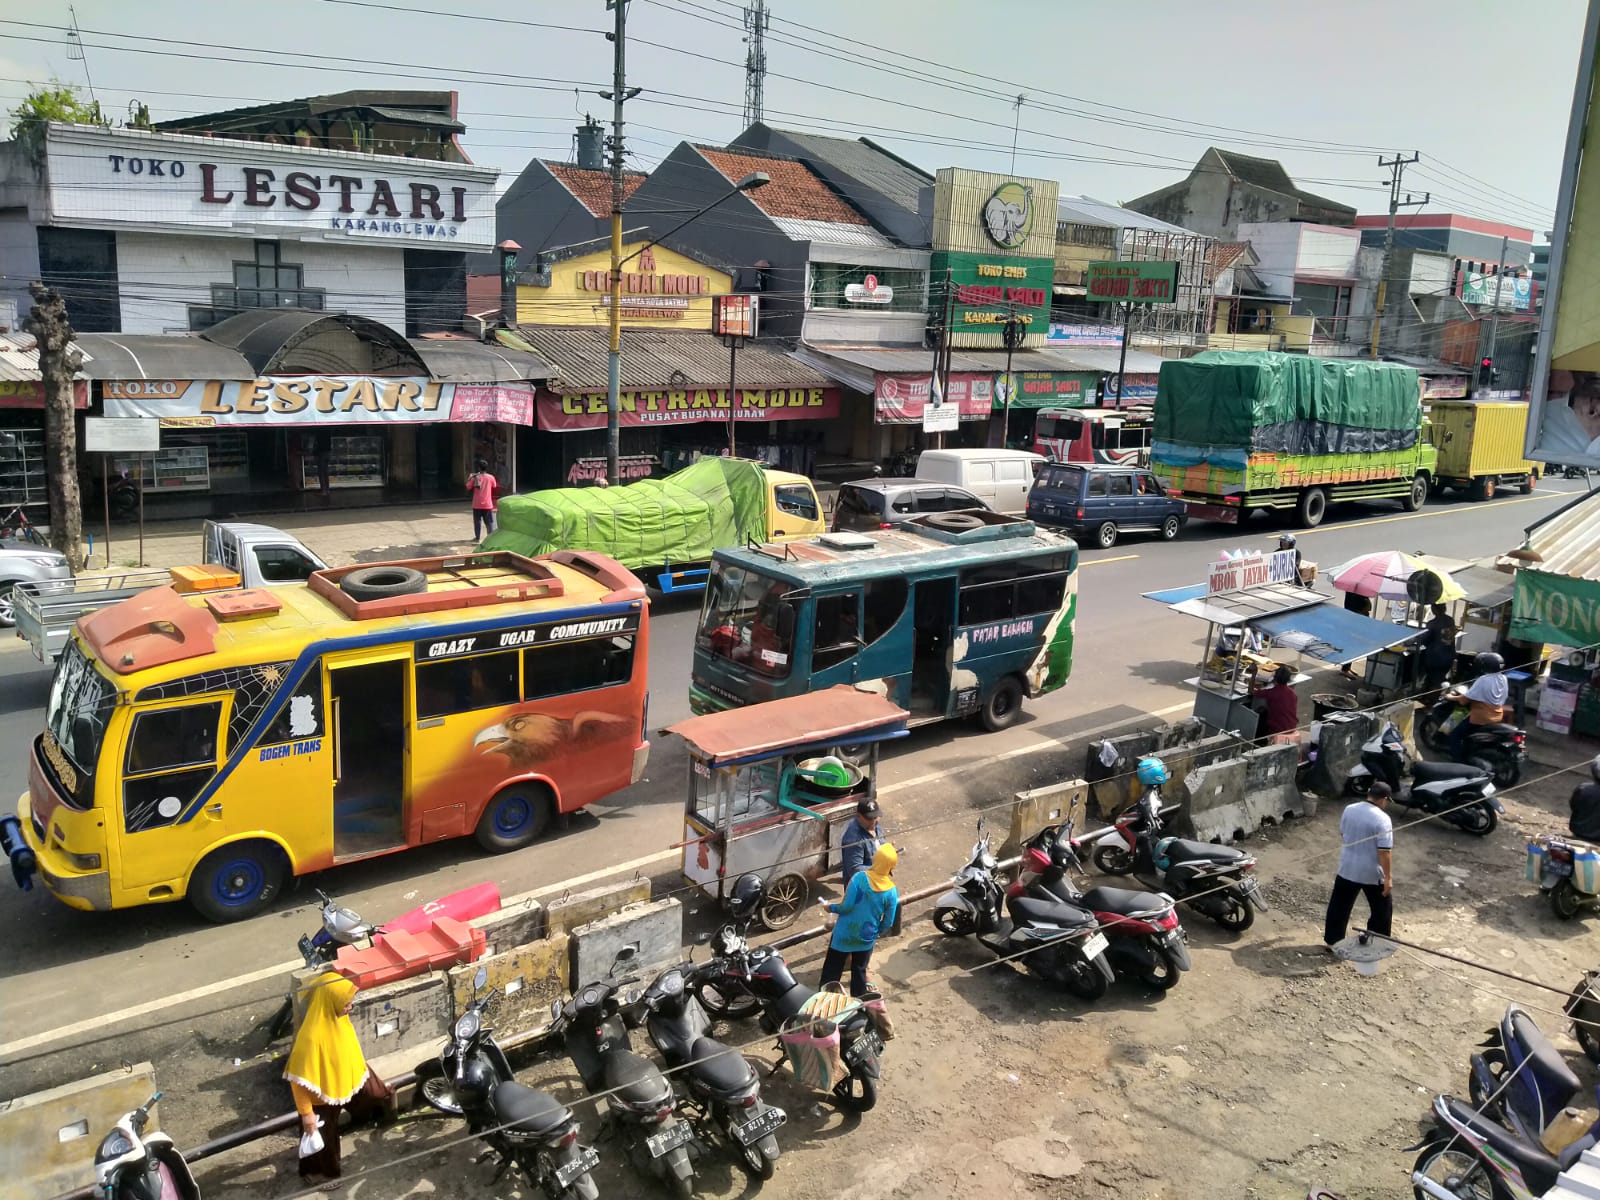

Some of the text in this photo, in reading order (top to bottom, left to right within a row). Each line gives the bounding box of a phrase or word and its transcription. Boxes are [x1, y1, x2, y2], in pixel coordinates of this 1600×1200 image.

[109, 155, 185, 178] TOKO
[199, 163, 468, 222] LESTARI
[331, 217, 458, 238] KARANGLEWAS
[109, 382, 177, 395] TOKO
[201, 377, 444, 414] LESTARI
[562, 388, 824, 415] CENTRAL MODE
[640, 411, 680, 423] PUSAT
[681, 408, 726, 420] BUSANA
[1210, 571, 1238, 593] MBOK
[1243, 564, 1269, 590] JAYAN
[429, 617, 627, 657] CRAZY UGAR COMMUNITY
[260, 739, 322, 762] BOGEM TRANS
